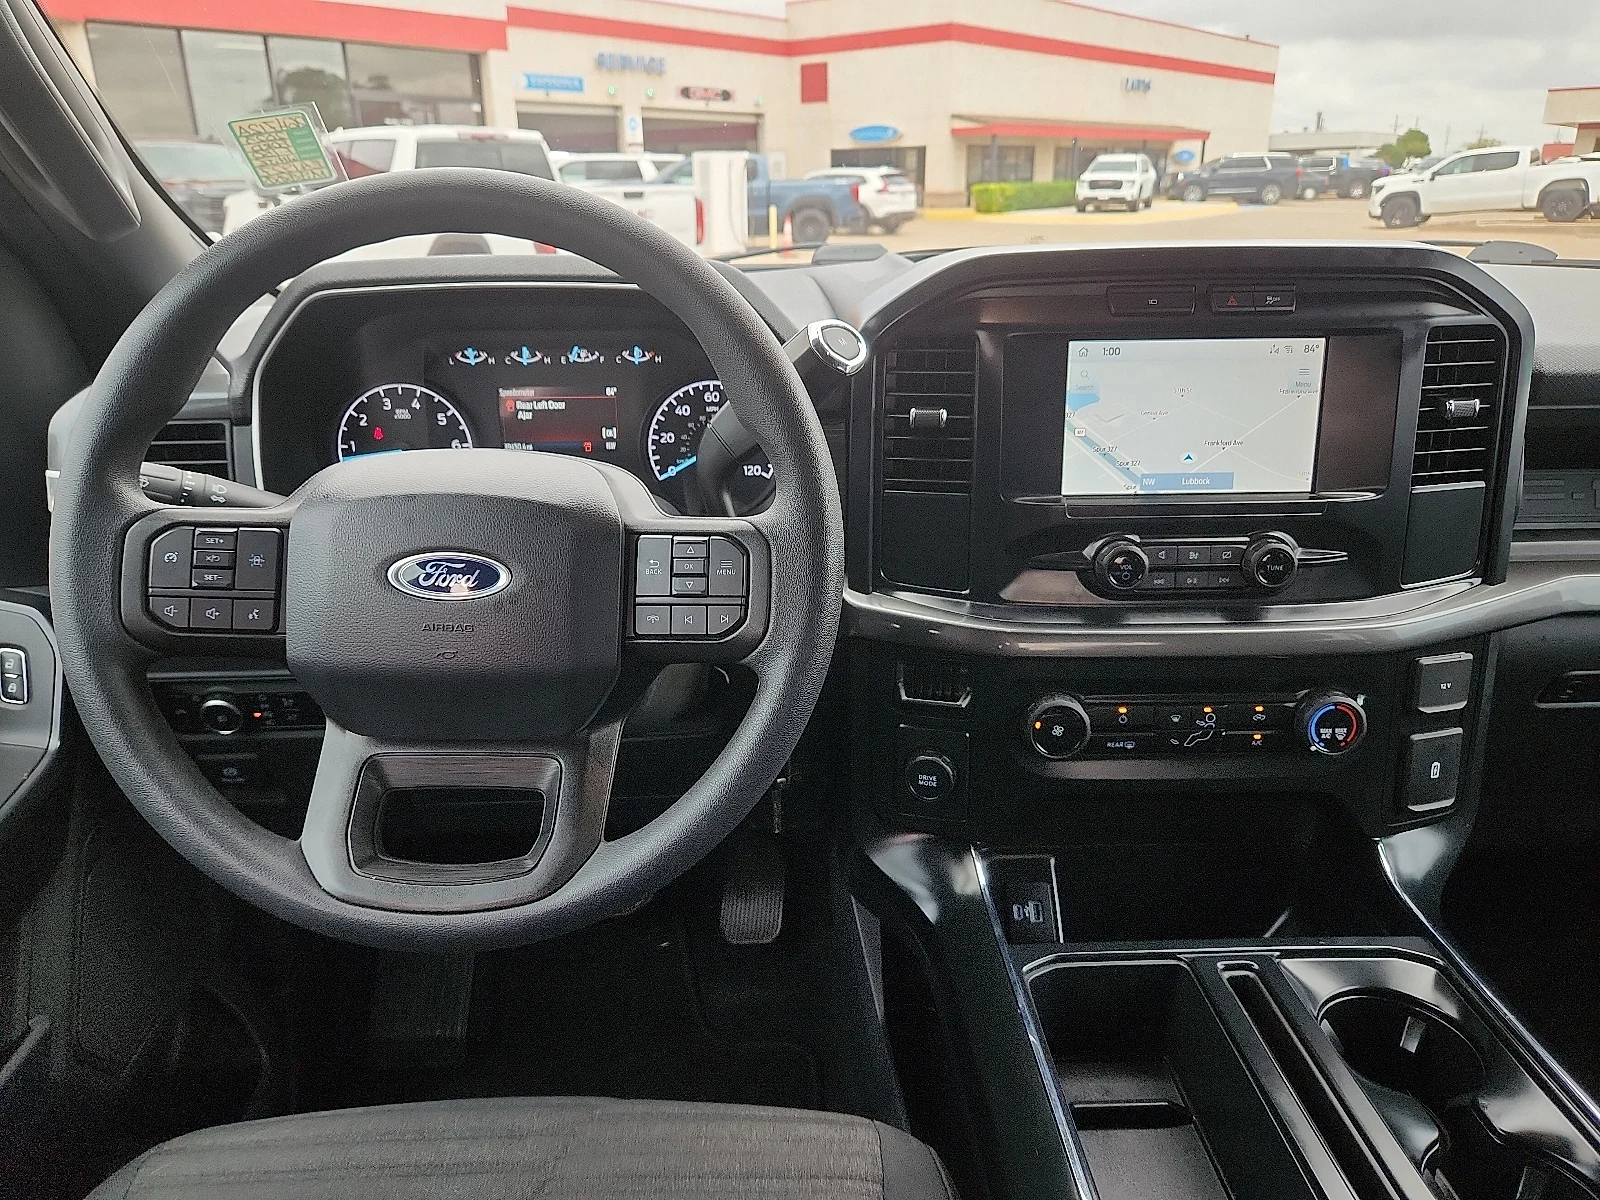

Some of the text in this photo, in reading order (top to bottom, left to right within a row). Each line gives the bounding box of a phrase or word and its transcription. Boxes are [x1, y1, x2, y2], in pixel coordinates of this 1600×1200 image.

[1102, 346, 1121, 357] 1:00
[1304, 344, 1320, 354] 84°
[704, 391, 720, 402] 60
[382, 398, 392, 410] 3
[411, 398, 420, 410] 4
[516, 400, 566, 410] Rear Left Door
[517, 411, 532, 420] Ajar
[674, 404, 691, 416] 40
[359, 414, 368, 426] 2
[436, 412, 447, 426] 5
[451, 438, 462, 449] 6
[660, 432, 675, 444] 20
[350, 440, 356, 452] 1
[743, 464, 762, 476] 120
[1142, 476, 1210, 486] NW Lubbock
[418, 561, 480, 589] Ford
[716, 568, 736, 576] MENU
[422, 622, 474, 633] AIRBAG
